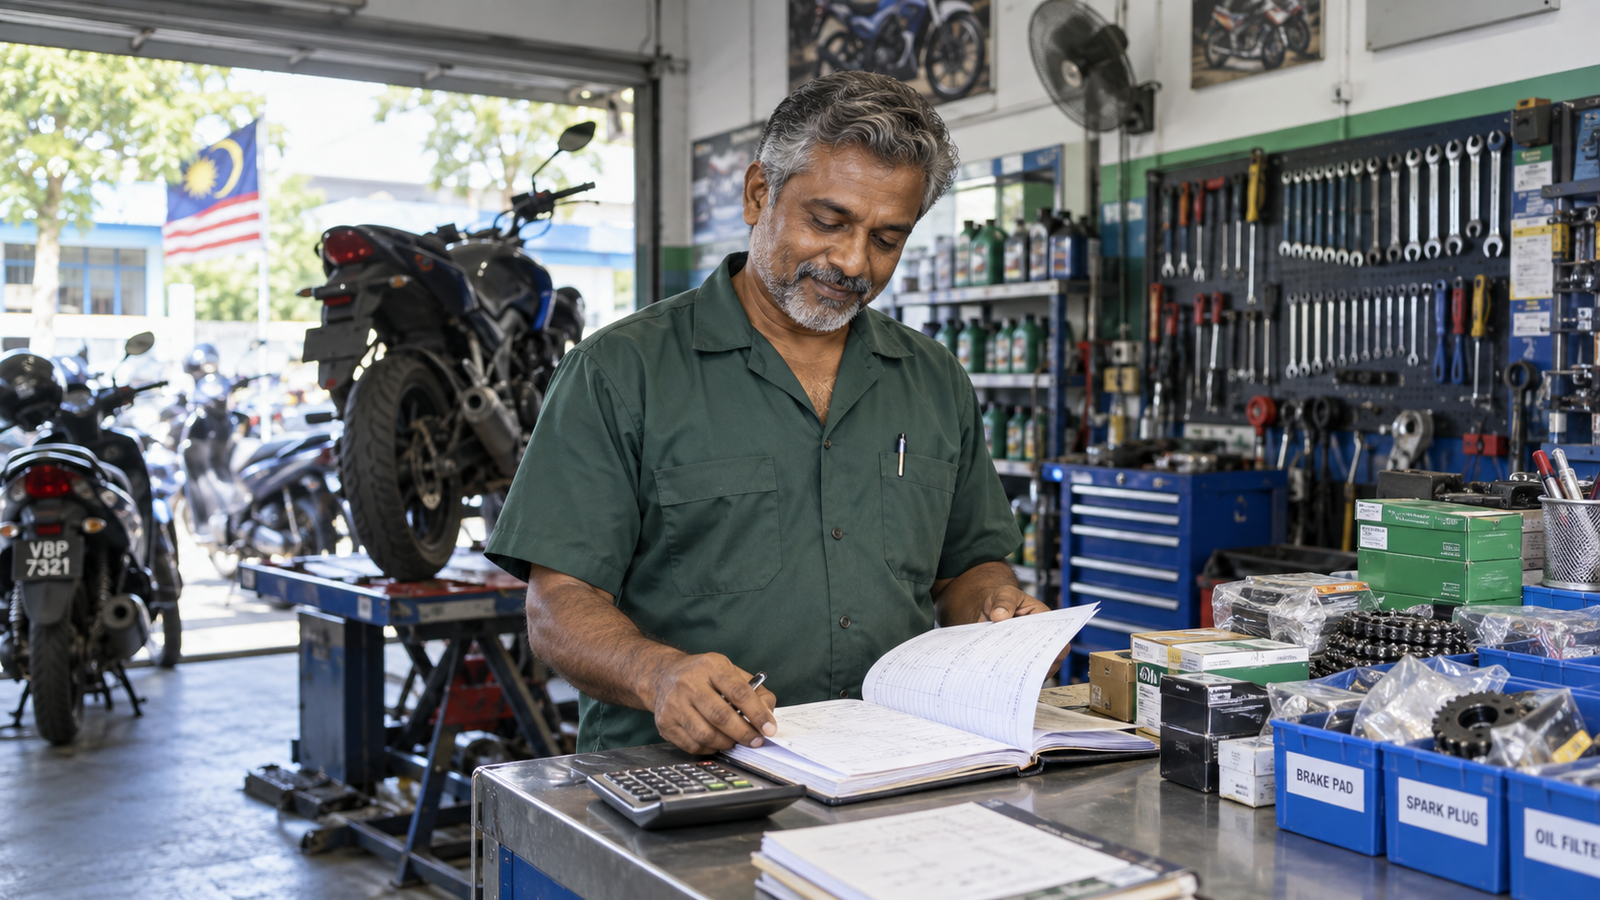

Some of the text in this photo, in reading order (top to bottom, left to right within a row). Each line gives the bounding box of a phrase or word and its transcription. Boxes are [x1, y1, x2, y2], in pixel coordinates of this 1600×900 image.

[29, 540, 69, 560] VBP
[26, 557, 70, 577] 7321
[1296, 768, 1354, 795] BRAKE PAD
[1406, 795, 1479, 826] SPARK PLUG
[1535, 828, 1557, 848] OIL
